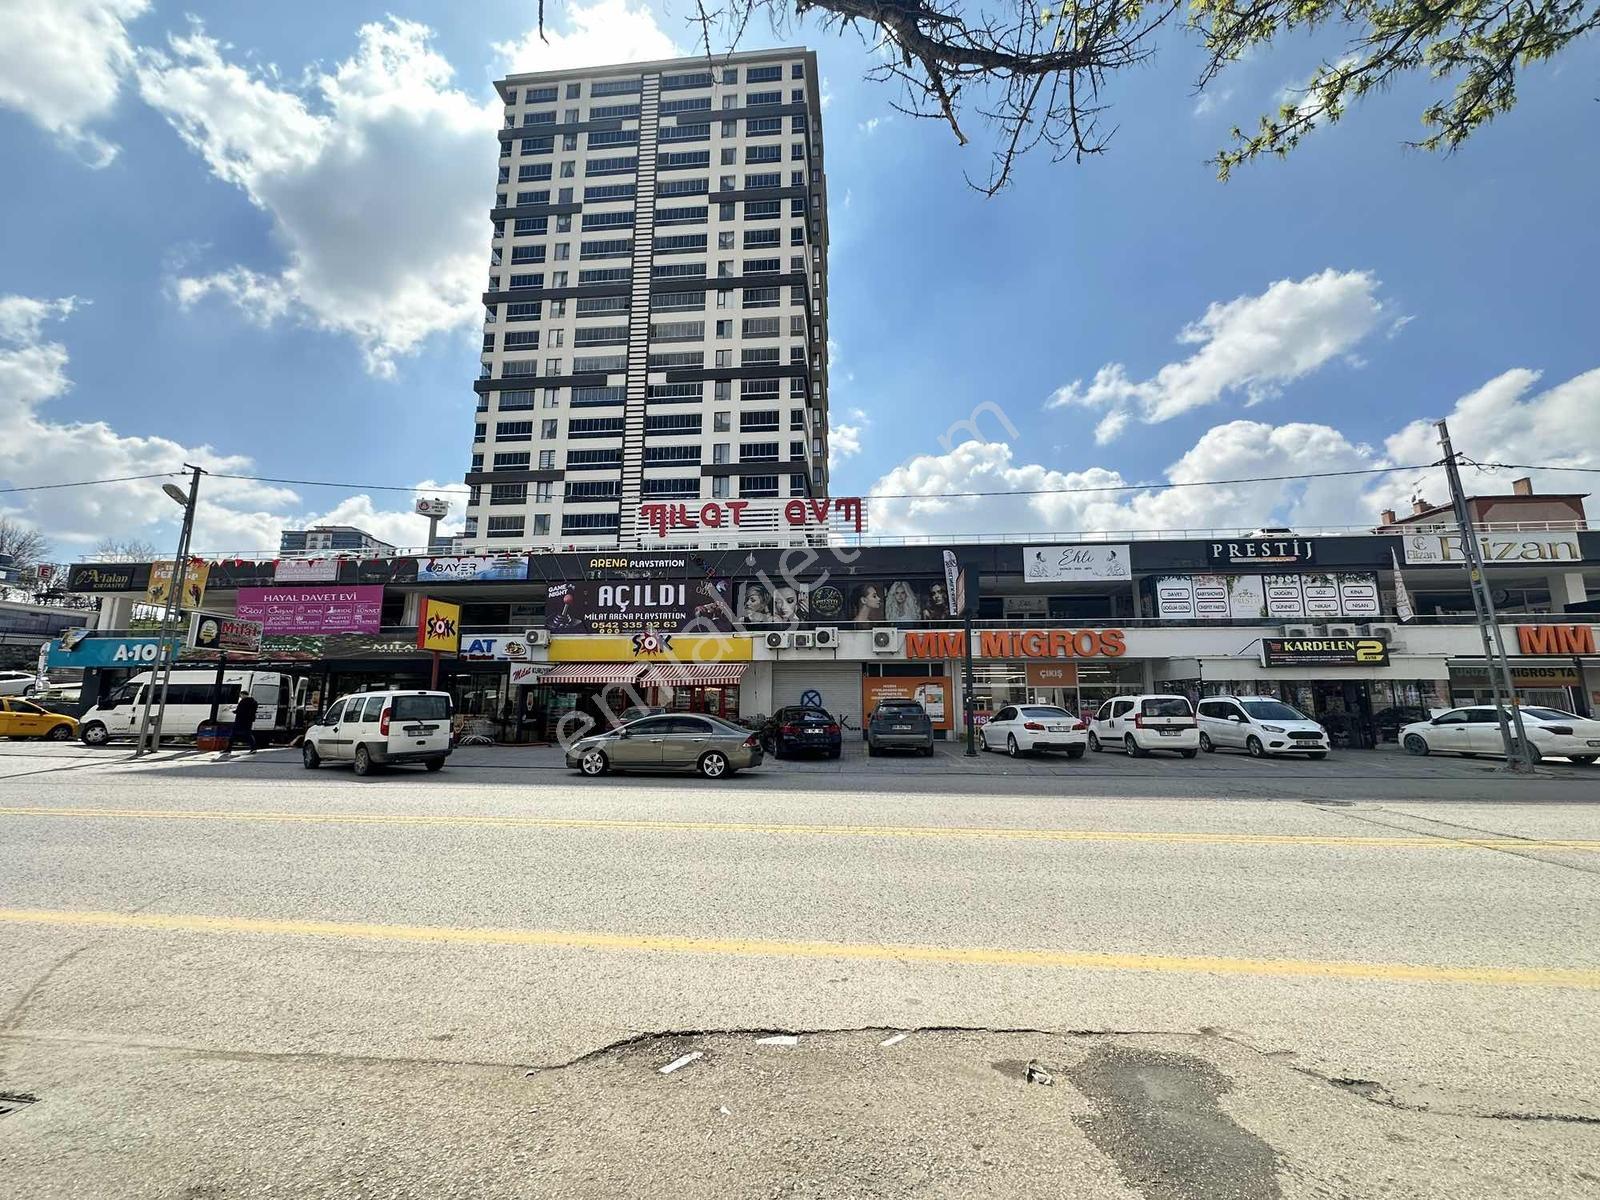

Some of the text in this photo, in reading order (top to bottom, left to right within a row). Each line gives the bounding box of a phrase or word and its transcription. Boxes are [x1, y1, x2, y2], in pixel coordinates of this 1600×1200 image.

[1212, 540, 1312, 560] PRESTİJ
[1439, 536, 1580, 561] Eizan
[436, 563, 477, 572] BAYER
[590, 558, 685, 568] ARENA PLAYSTATION
[548, 583, 567, 593] GAME
[548, 589, 568, 598] NIGHT
[263, 592, 357, 602] HAYAL DAVET EVİ
[598, 584, 686, 612] AÇILDI
[609, 612, 633, 620] ARENA
[635, 612, 686, 620] PLAYSTATION
[906, 631, 967, 659] MM
[1517, 625, 1596, 654] MM
[460, 639, 497, 653] AT
[1283, 641, 1355, 651] KARDELEN
[1356, 640, 1384, 661] 2
[1039, 670, 1063, 679] ÇIKIŞ
